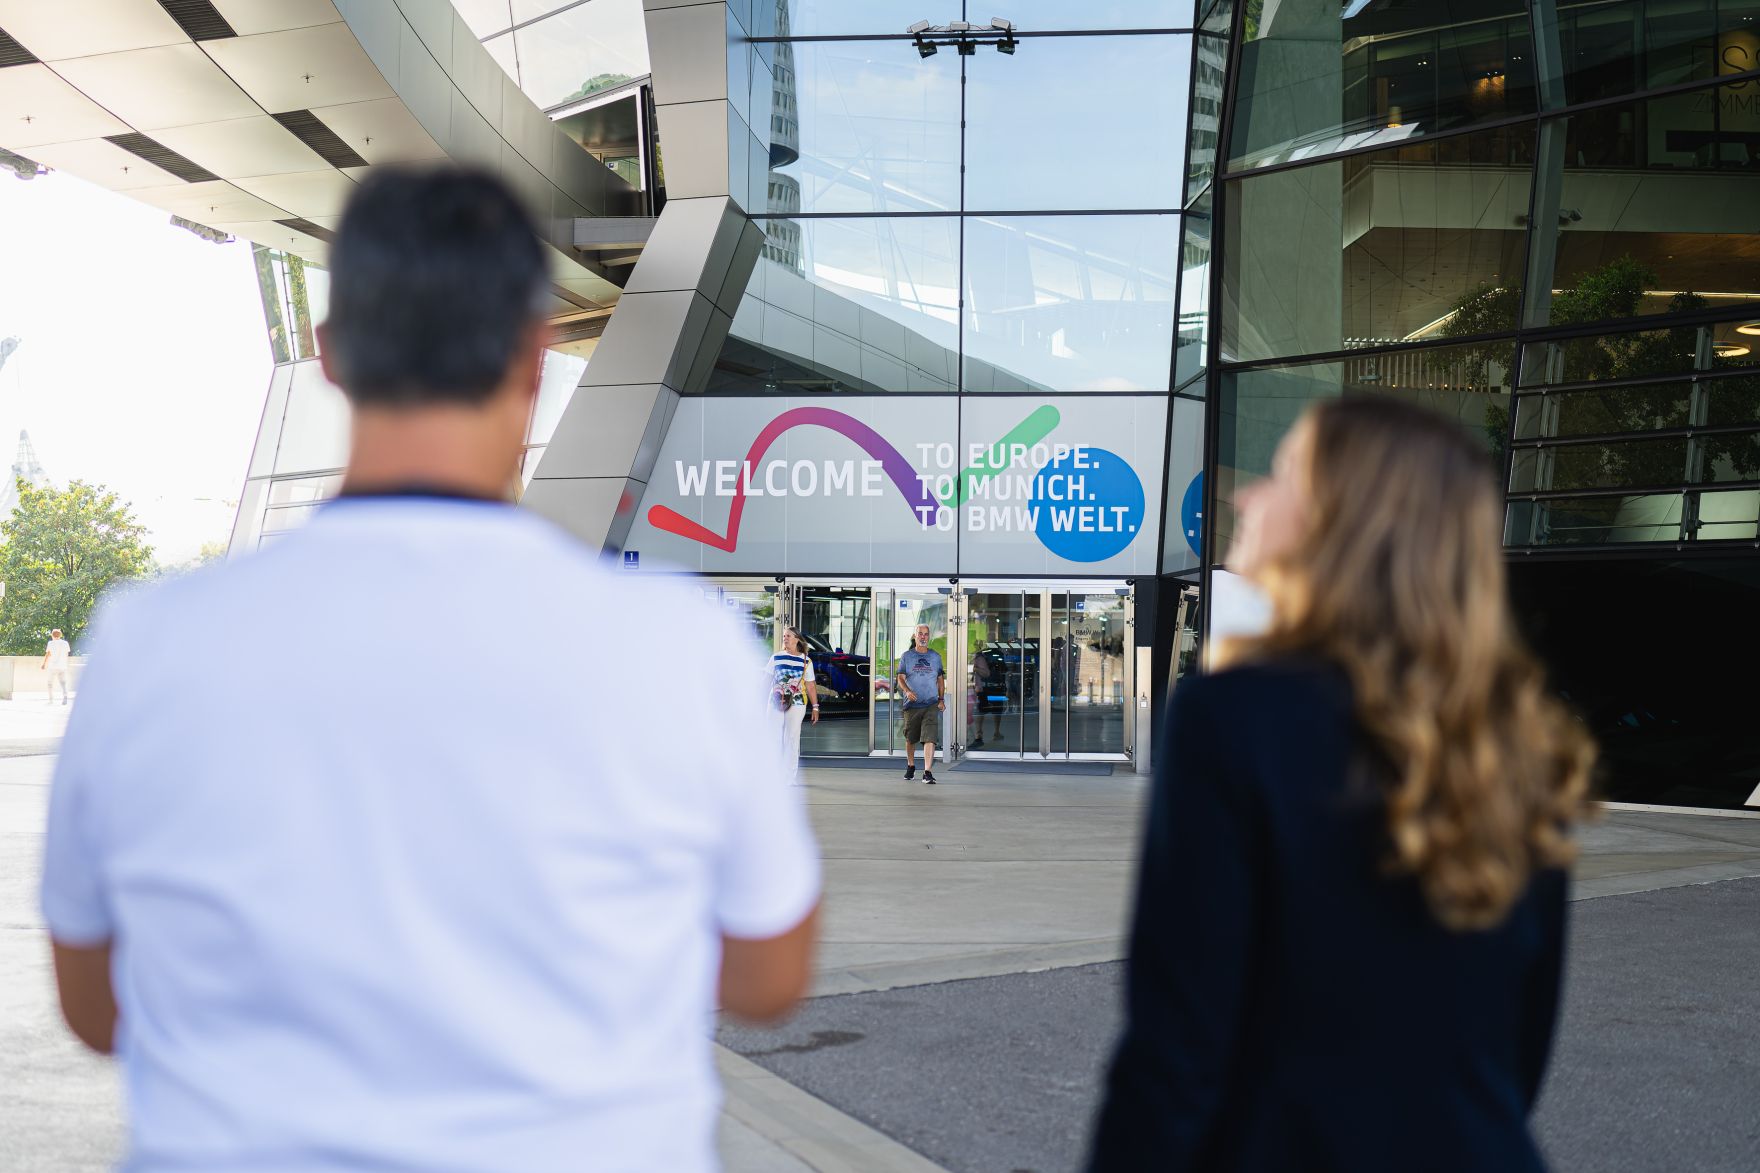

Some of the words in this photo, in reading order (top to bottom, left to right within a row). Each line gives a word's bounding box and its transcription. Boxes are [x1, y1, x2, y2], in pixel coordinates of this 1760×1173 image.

[916, 443, 954, 469] TO
[968, 443, 1100, 469] EUROPE.
[675, 459, 884, 497] WELCOME
[916, 474, 954, 500] TO
[968, 474, 1096, 500] MUNICH.
[916, 506, 954, 532] TO
[968, 506, 1040, 532] BMW
[1050, 506, 1136, 533] WELT.
